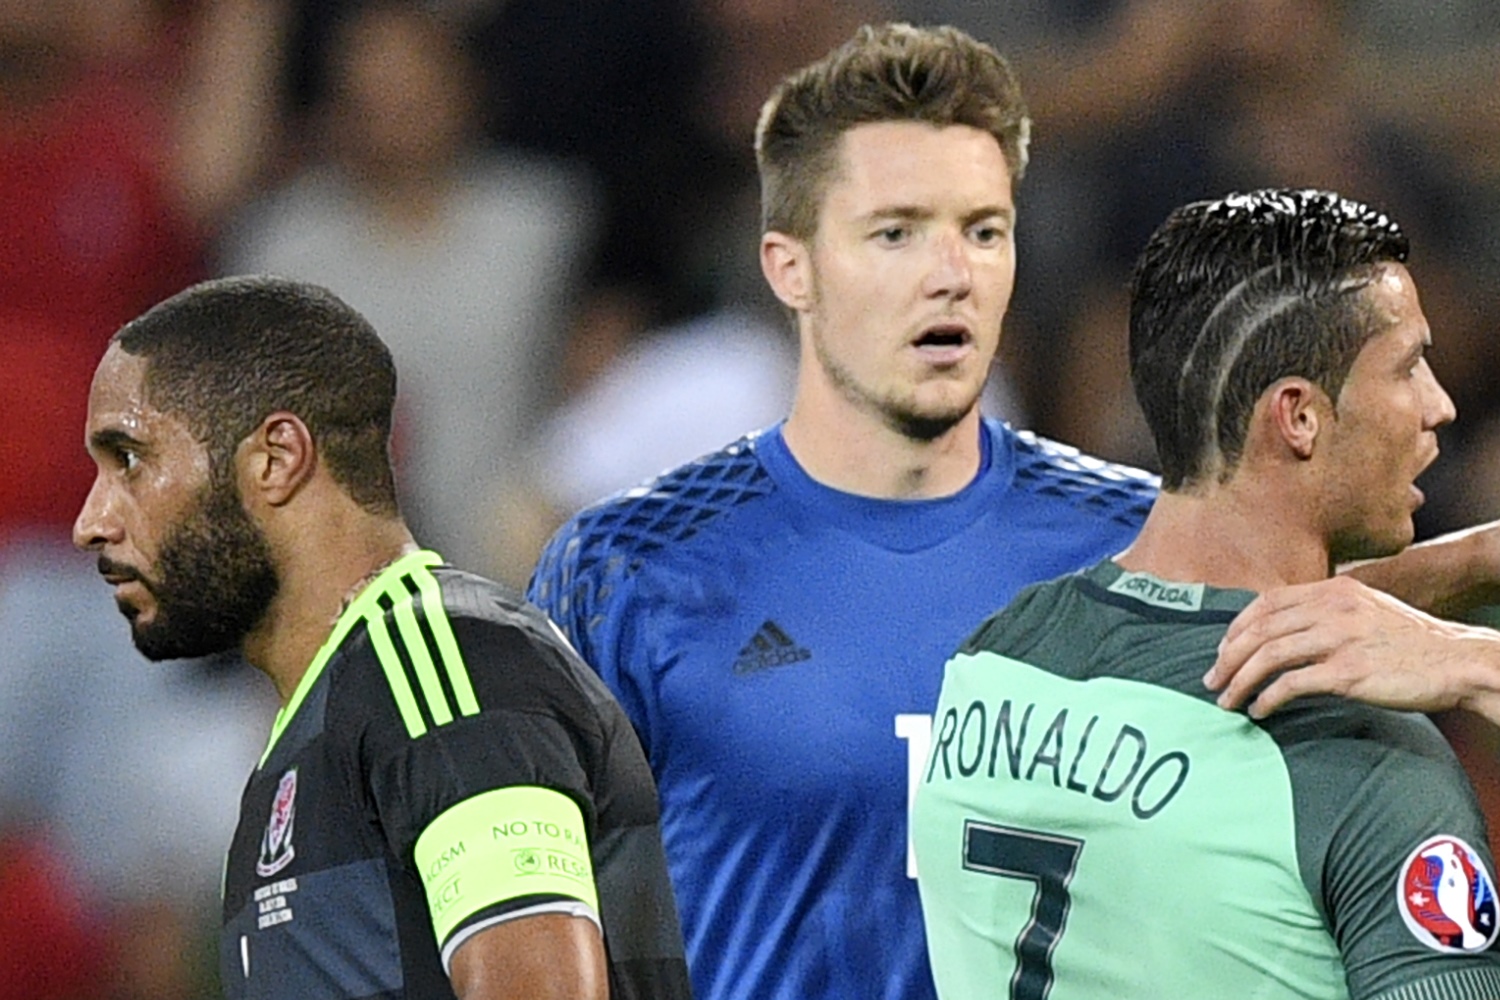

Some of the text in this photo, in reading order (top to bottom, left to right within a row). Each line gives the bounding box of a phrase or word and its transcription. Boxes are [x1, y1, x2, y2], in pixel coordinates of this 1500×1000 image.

[926, 699, 1190, 819] RONALDO
[493, 822, 528, 840] NO
[532, 822, 560, 837] TO
